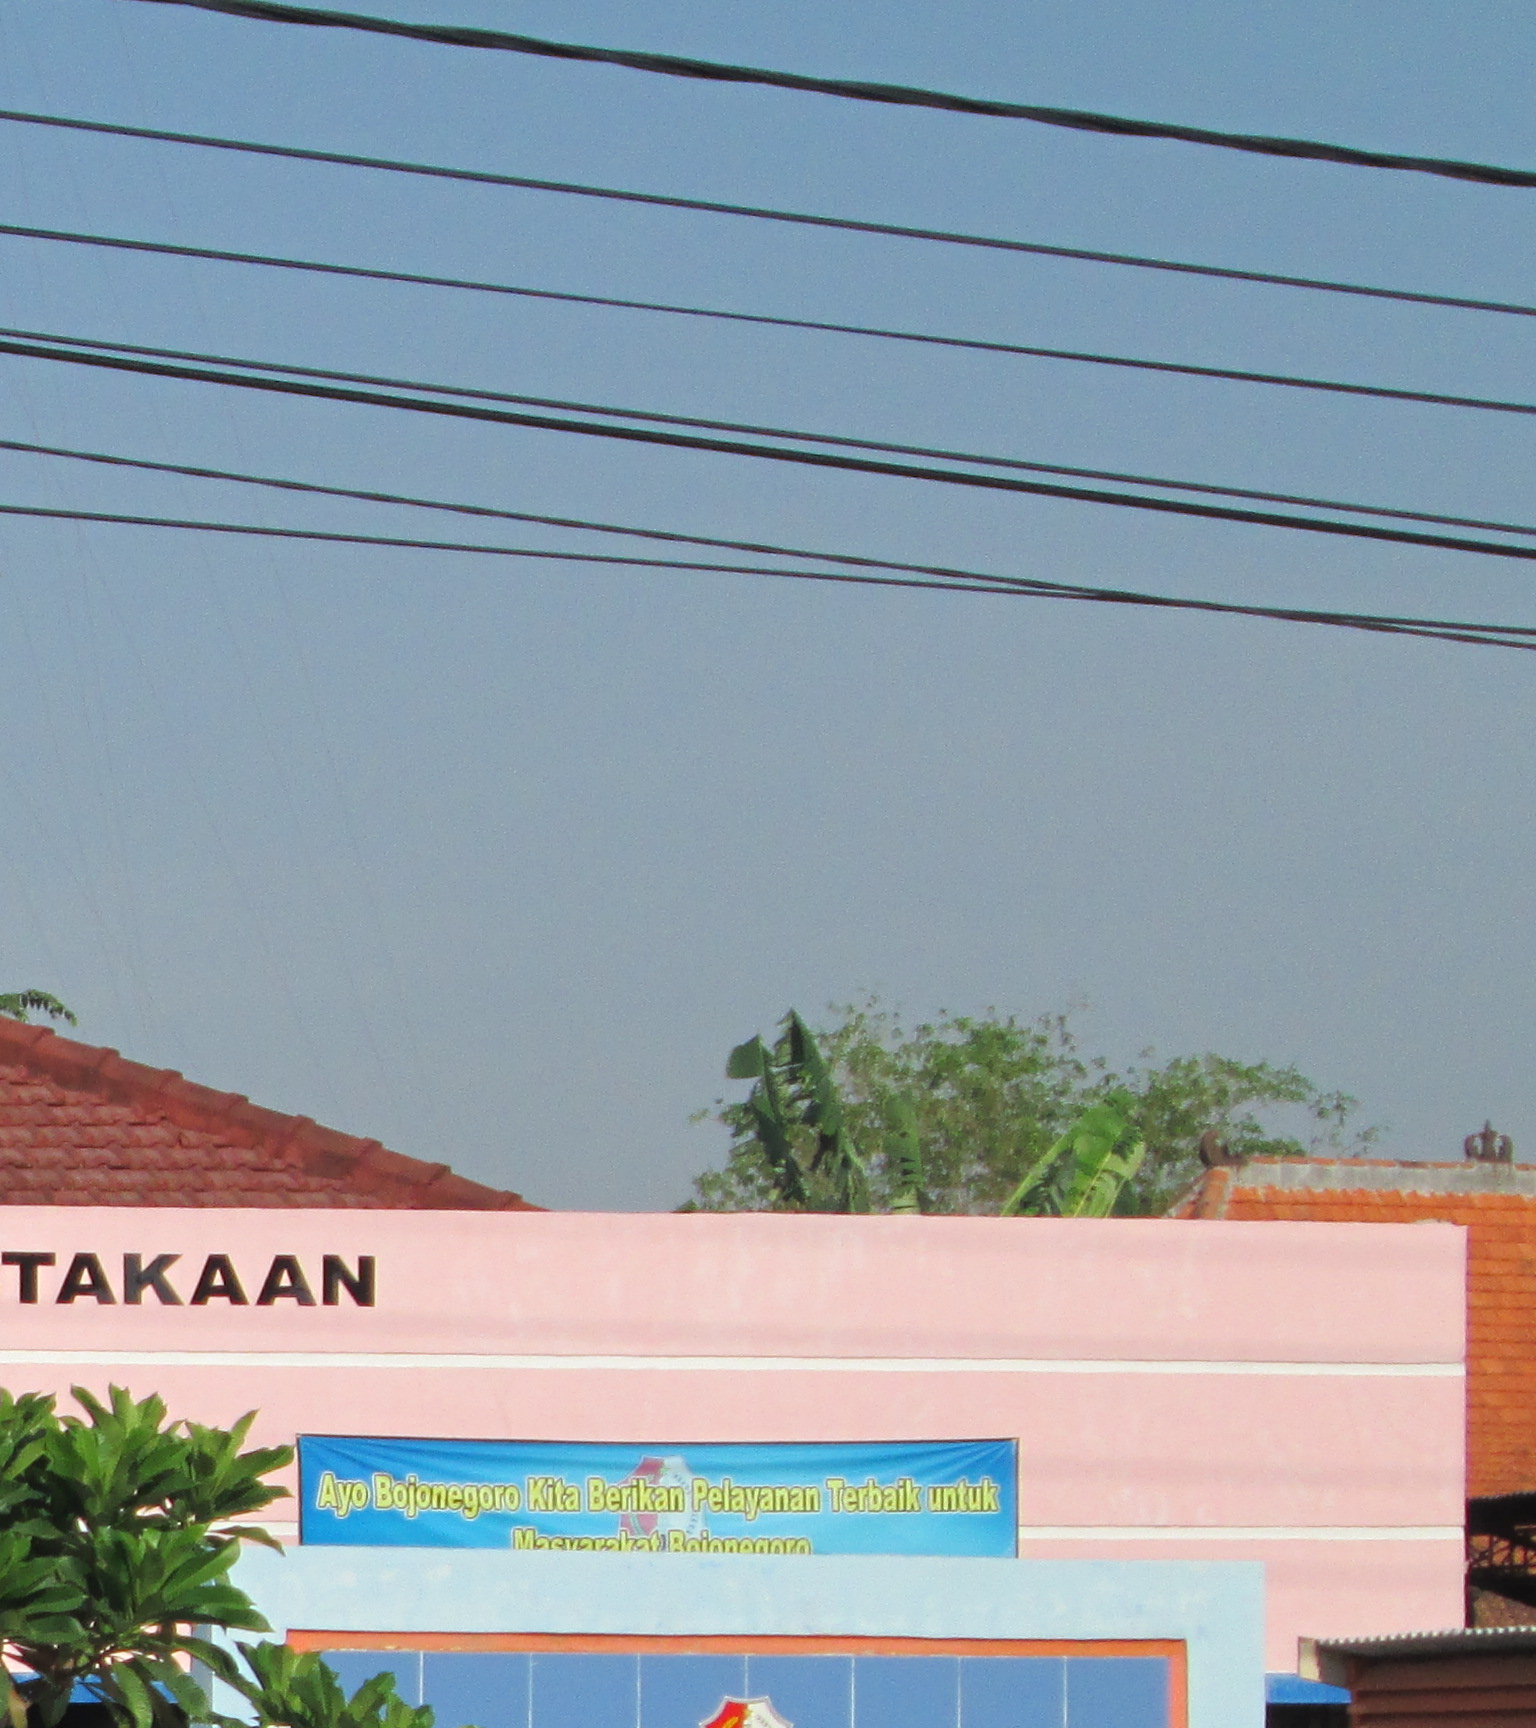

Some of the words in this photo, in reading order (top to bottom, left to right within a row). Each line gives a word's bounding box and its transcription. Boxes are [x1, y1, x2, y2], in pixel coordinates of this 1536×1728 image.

[319, 1472, 368, 1516] Ayo
[374, 1474, 519, 1519] Bojonegoro
[528, 1477, 580, 1513] Kita
[588, 1477, 684, 1513] Berikan
[692, 1479, 820, 1520] Pelayanan
[827, 1479, 921, 1512] Terbaik
[928, 1479, 998, 1512] untuk
